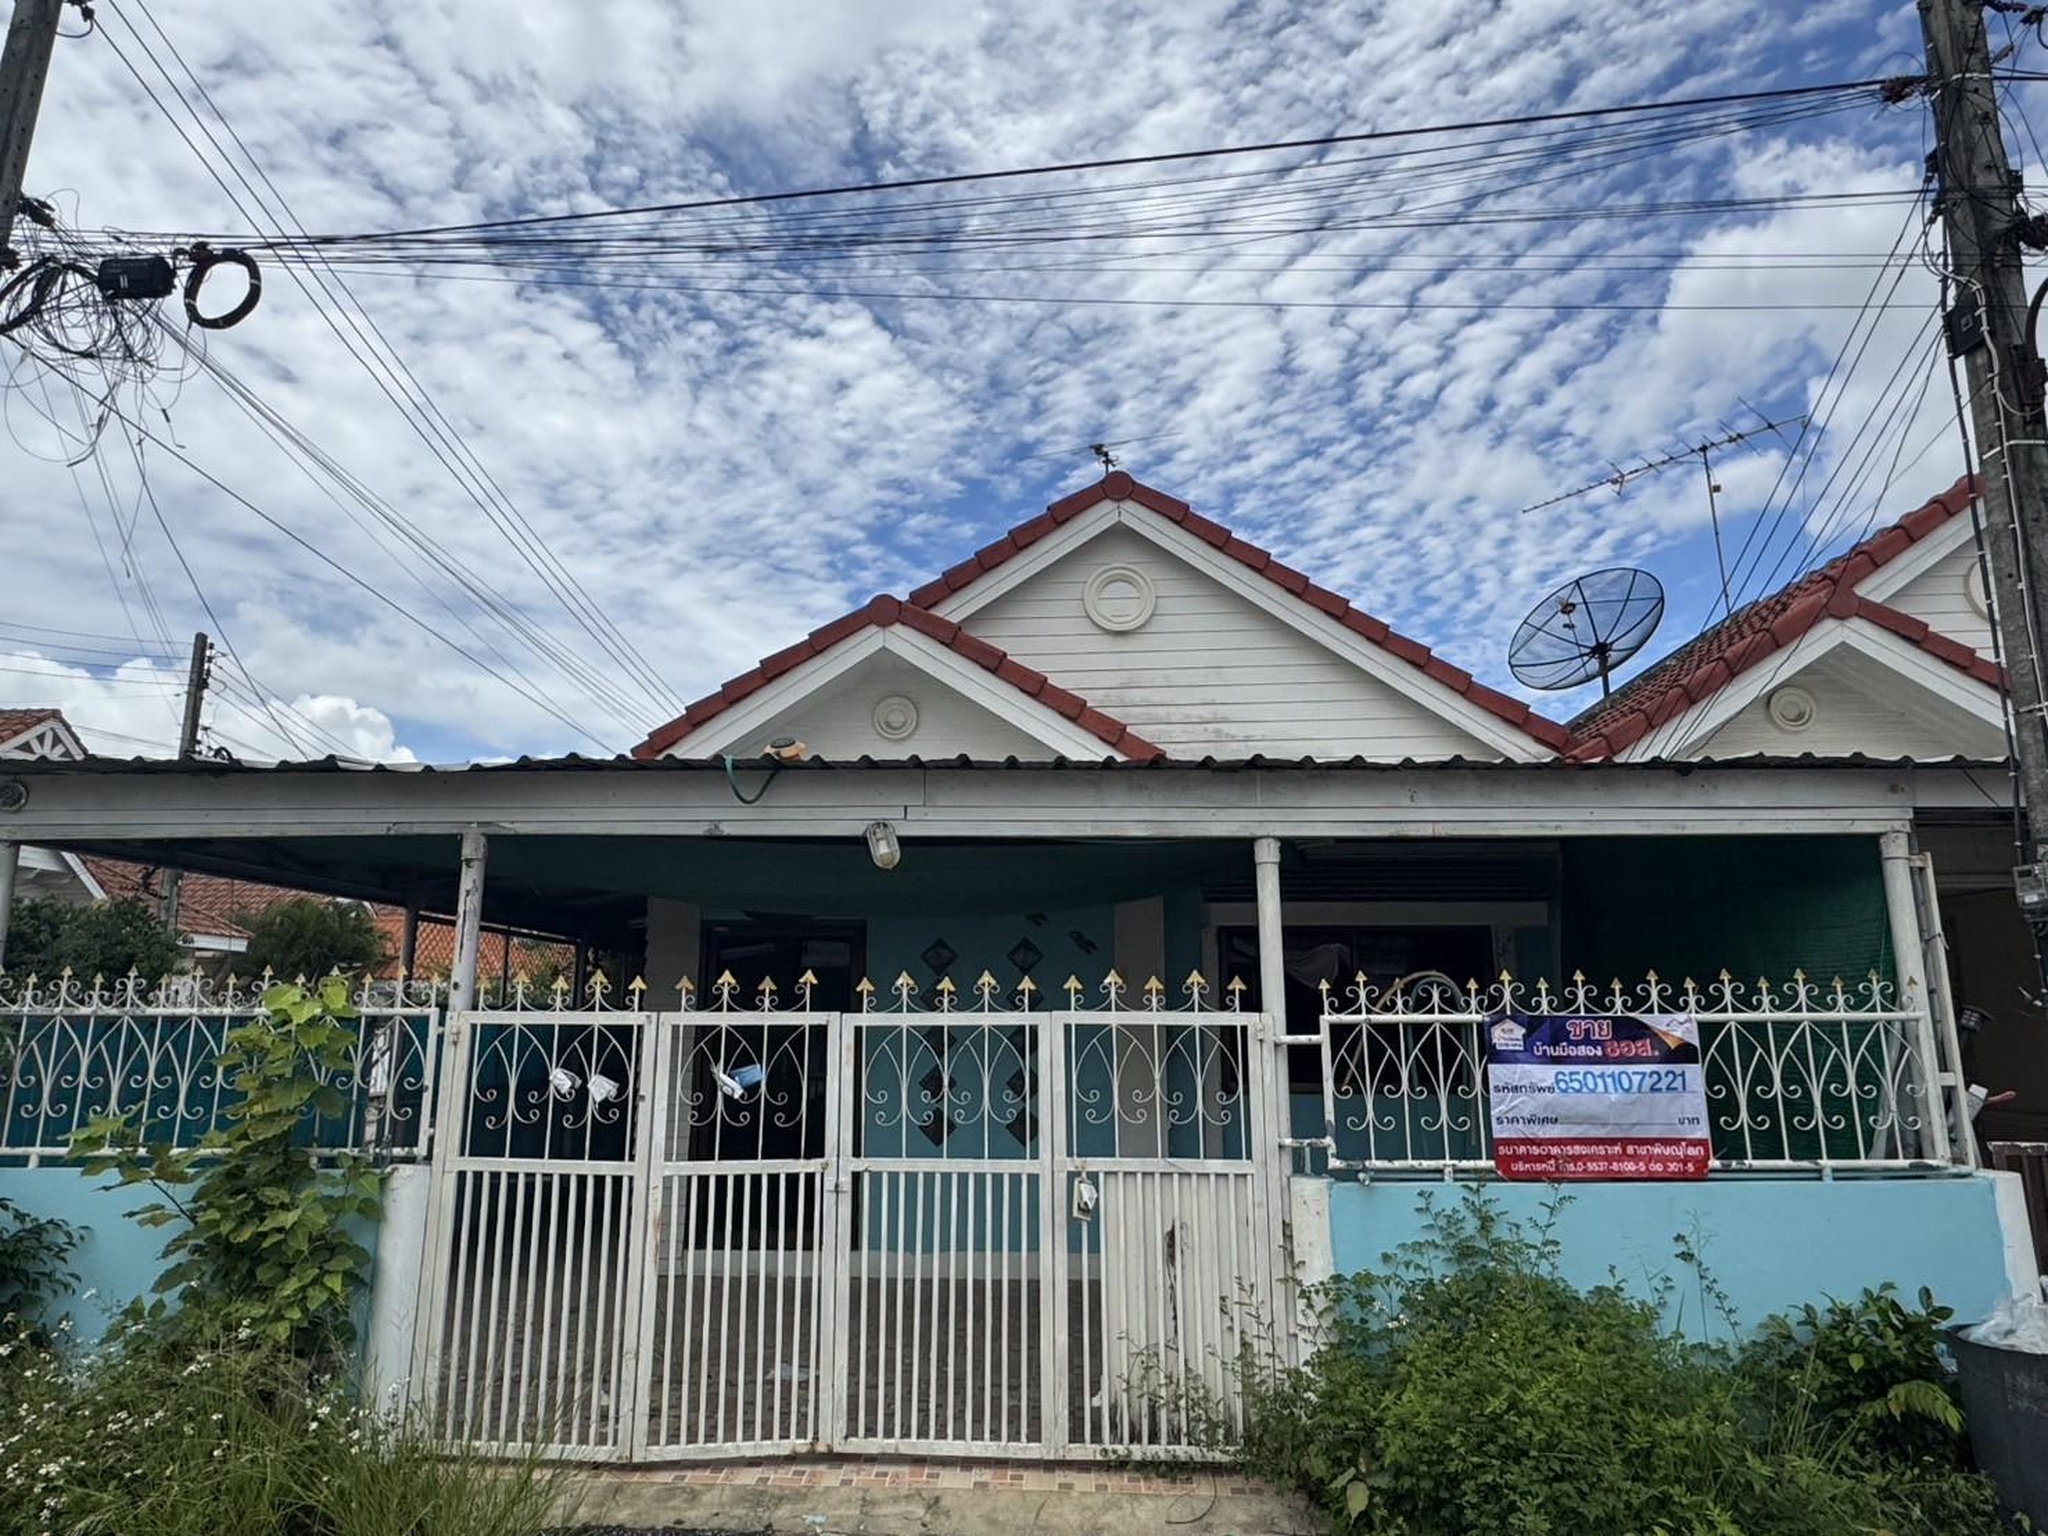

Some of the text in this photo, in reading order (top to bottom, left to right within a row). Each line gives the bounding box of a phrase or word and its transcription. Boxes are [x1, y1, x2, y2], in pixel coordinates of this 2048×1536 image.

[1566, 1019, 1612, 1040] ขาย
[1533, 1041, 1602, 1056] บ้านมือสอง
[1554, 1070, 1688, 1094] 6501107221
[1496, 1114, 1700, 1126] ราคาพิเศษ บาท
